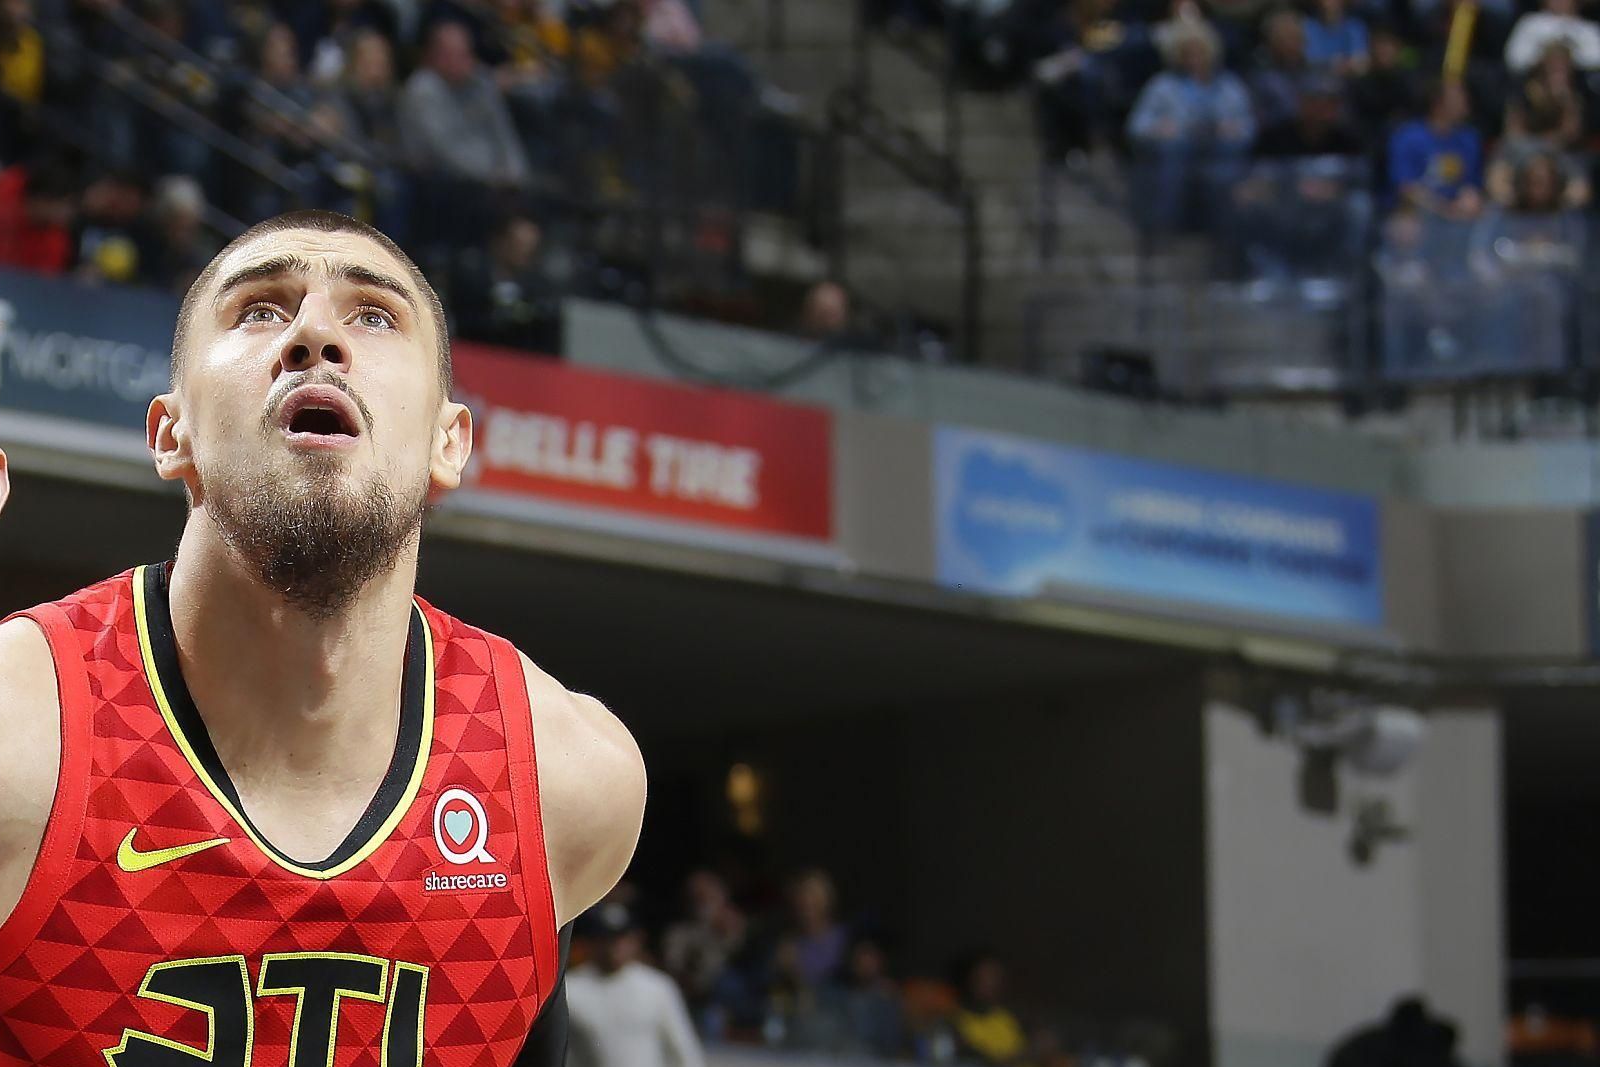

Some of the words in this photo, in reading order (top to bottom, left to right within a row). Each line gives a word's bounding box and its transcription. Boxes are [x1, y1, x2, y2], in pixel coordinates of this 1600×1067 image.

[486, 406, 639, 491] BELLE
[645, 432, 763, 511] TIRE
[425, 871, 508, 891] sharecare
